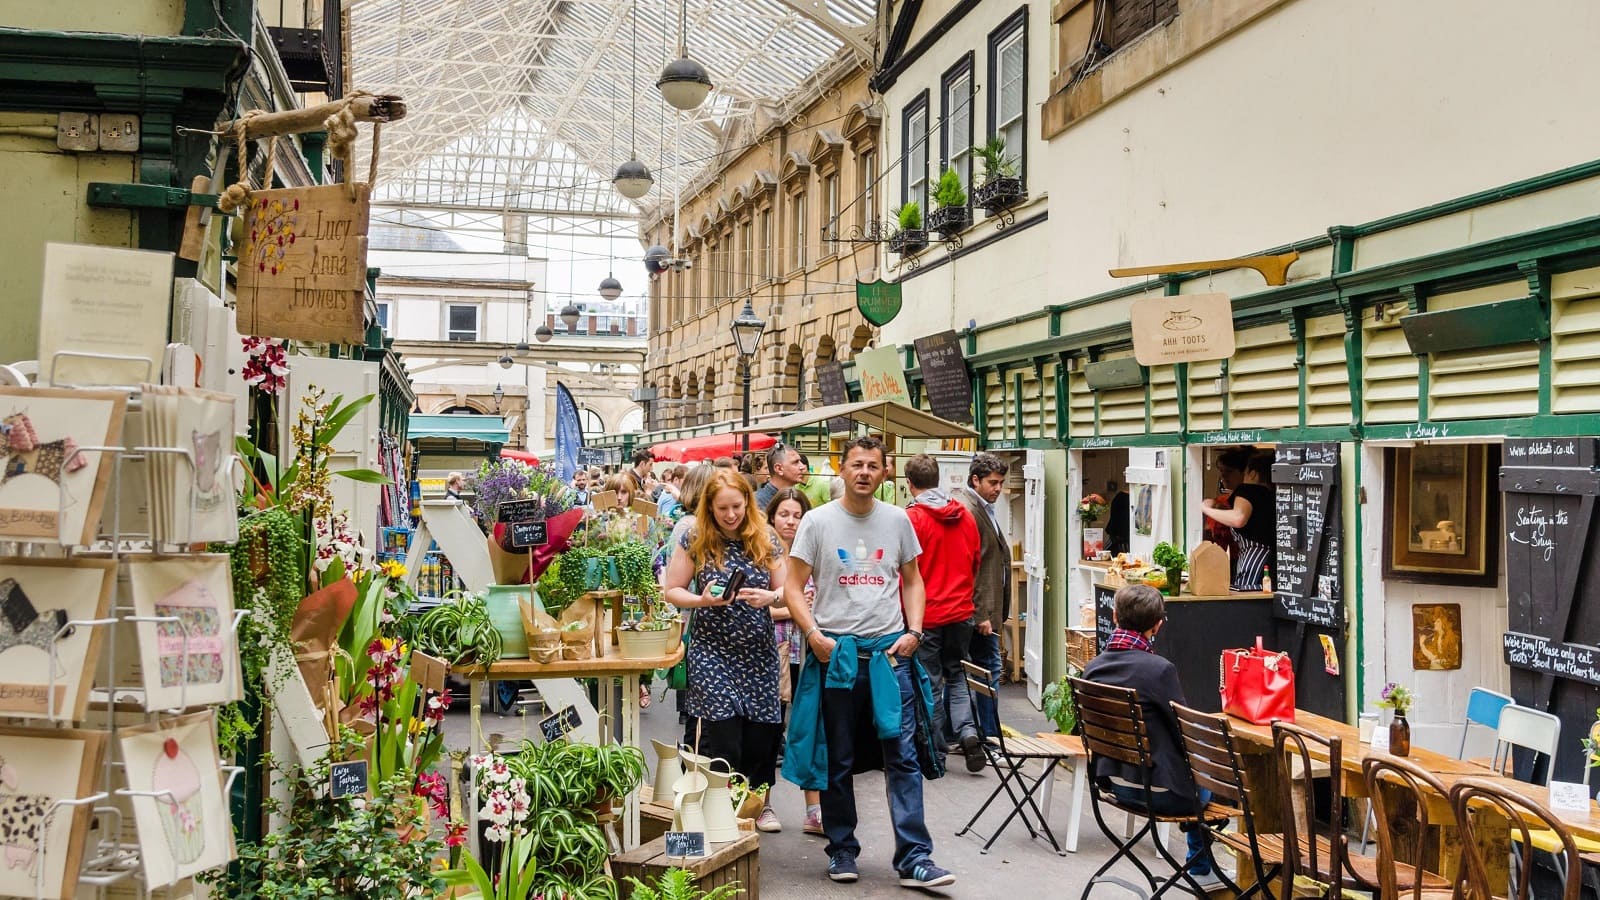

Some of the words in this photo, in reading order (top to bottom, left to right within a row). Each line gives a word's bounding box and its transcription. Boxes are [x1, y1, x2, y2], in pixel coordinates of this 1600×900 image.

[316, 210, 352, 251] Lucy
[309, 254, 347, 275] Anna
[290, 277, 347, 310] Flowers
[1162, 337, 1177, 346] AHH
[1182, 334, 1206, 345] TOOTS
[1414, 423, 1438, 437] Snug
[1515, 505, 1548, 537] Seating
[1556, 510, 1569, 525] the
[1530, 530, 1557, 562] Snug
[838, 571, 885, 585] adidas
[1531, 652, 1551, 669] food
[1538, 640, 1560, 657] Please
[1560, 646, 1576, 666] only
[1577, 650, 1593, 664] eat
